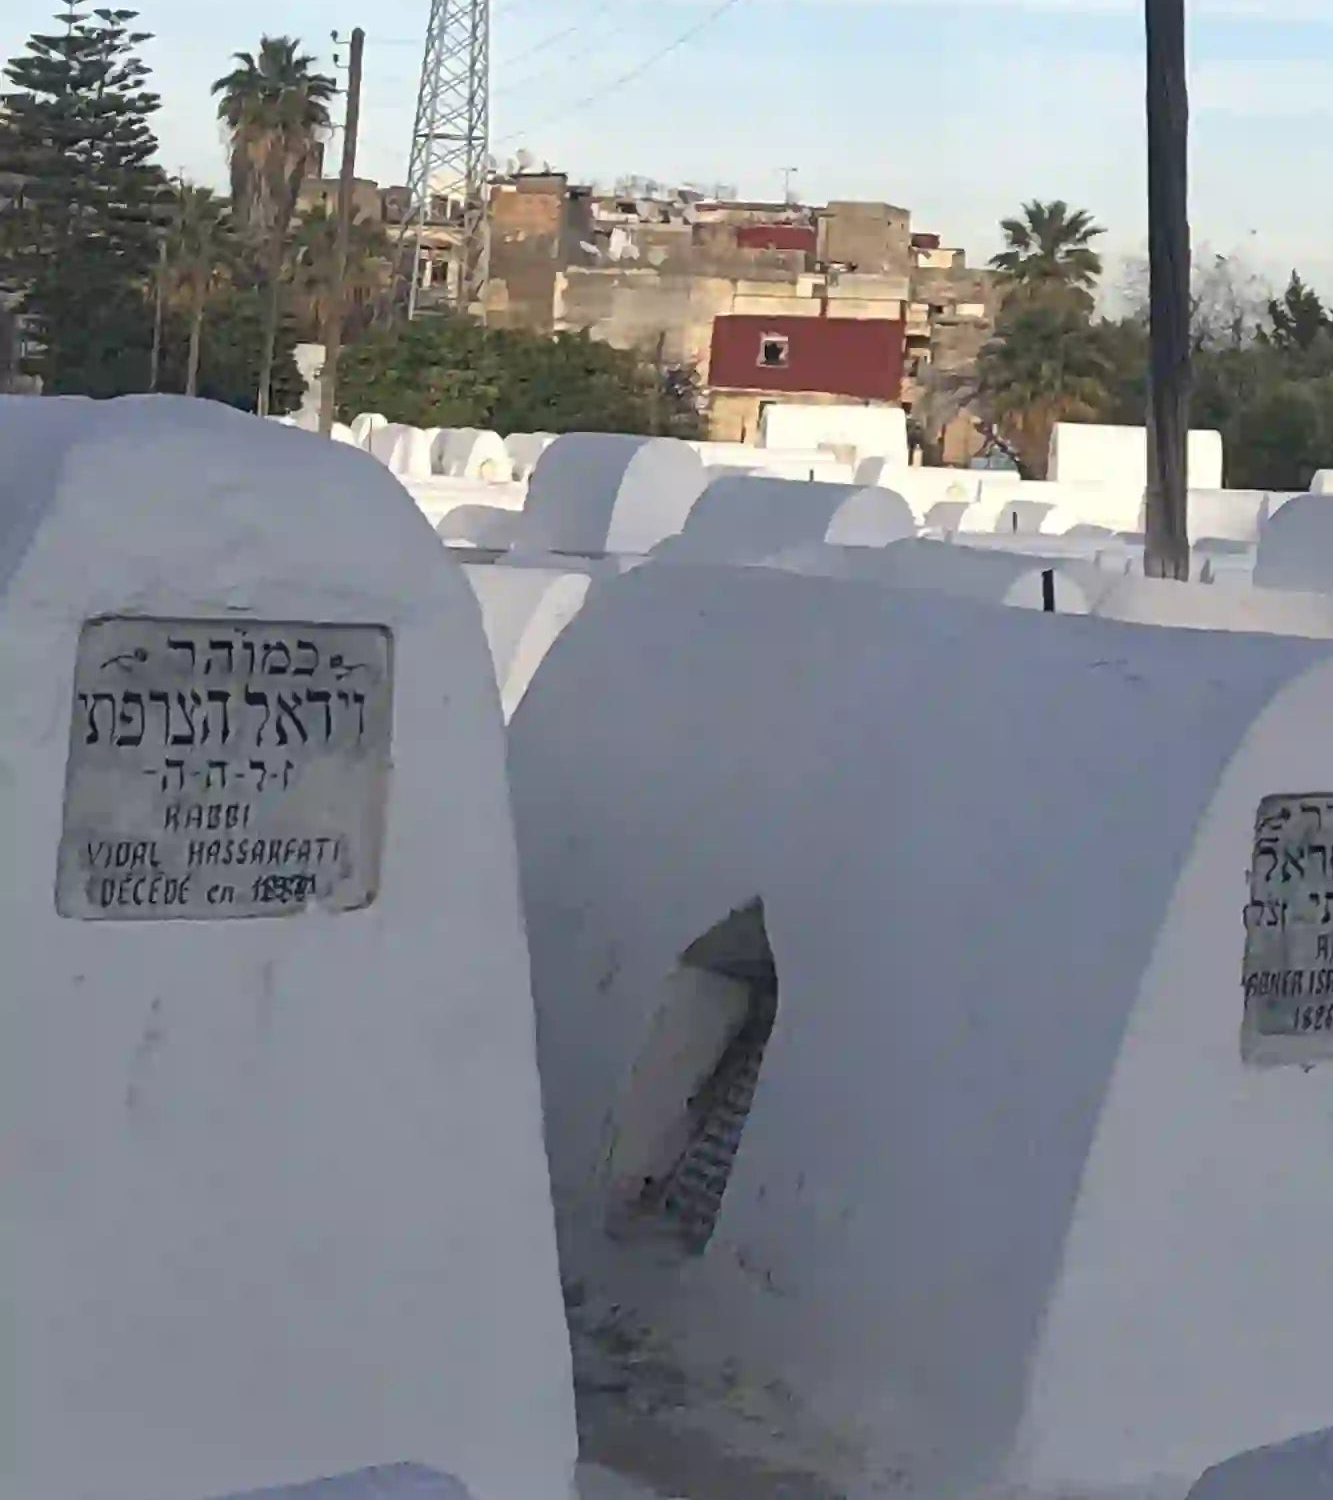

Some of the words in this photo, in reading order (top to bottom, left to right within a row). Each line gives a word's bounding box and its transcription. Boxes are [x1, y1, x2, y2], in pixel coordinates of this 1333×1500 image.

[163, 802, 251, 831] RABBI
[86, 841, 162, 870] VIDAL
[187, 837, 342, 868] HASSARFATI
[206, 883, 235, 905] en
